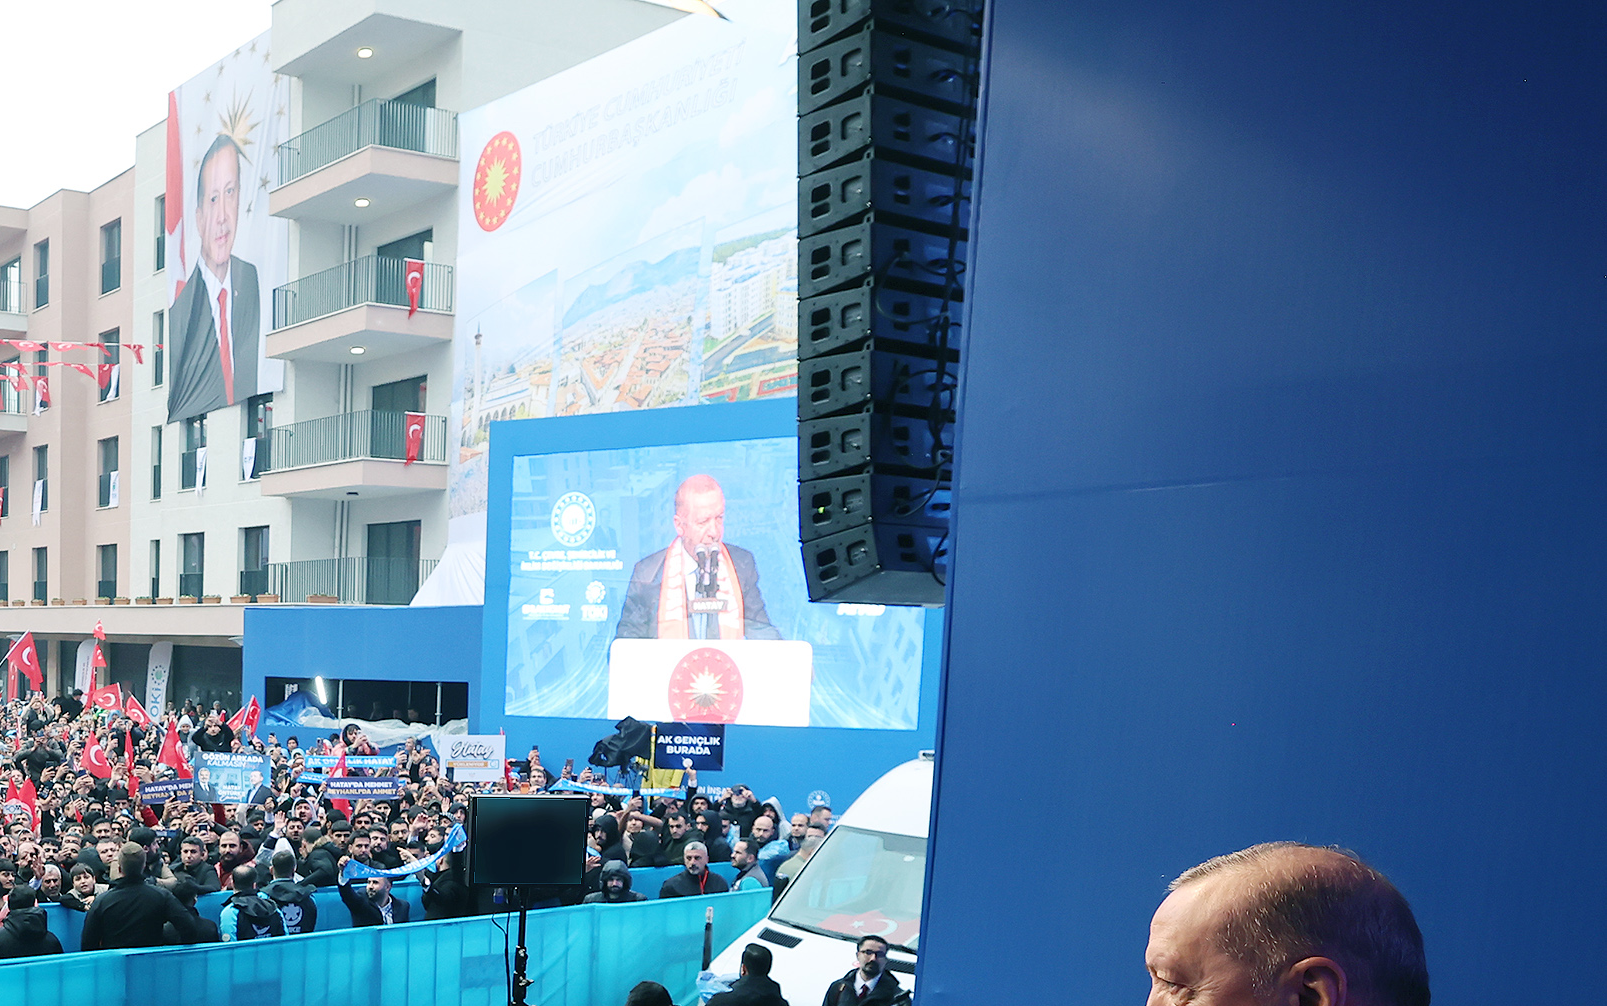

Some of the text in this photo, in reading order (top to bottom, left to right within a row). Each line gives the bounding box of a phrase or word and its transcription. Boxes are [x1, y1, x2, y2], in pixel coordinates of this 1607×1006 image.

[533, 103, 601, 155] TÜRKİYE
[603, 37, 747, 122] CUMHURİYETİ
[530, 77, 738, 188] CUMHURBAŞKANLIĞI
[150, 688, 161, 717] OKİ
[658, 735, 673, 744] AK
[451, 741, 493, 759] Hatay
[666, 746, 711, 755] BURADA
[202, 752, 264, 763] GÖZÜN ARKADA
[707, 785, 728, 795] İNŞA
